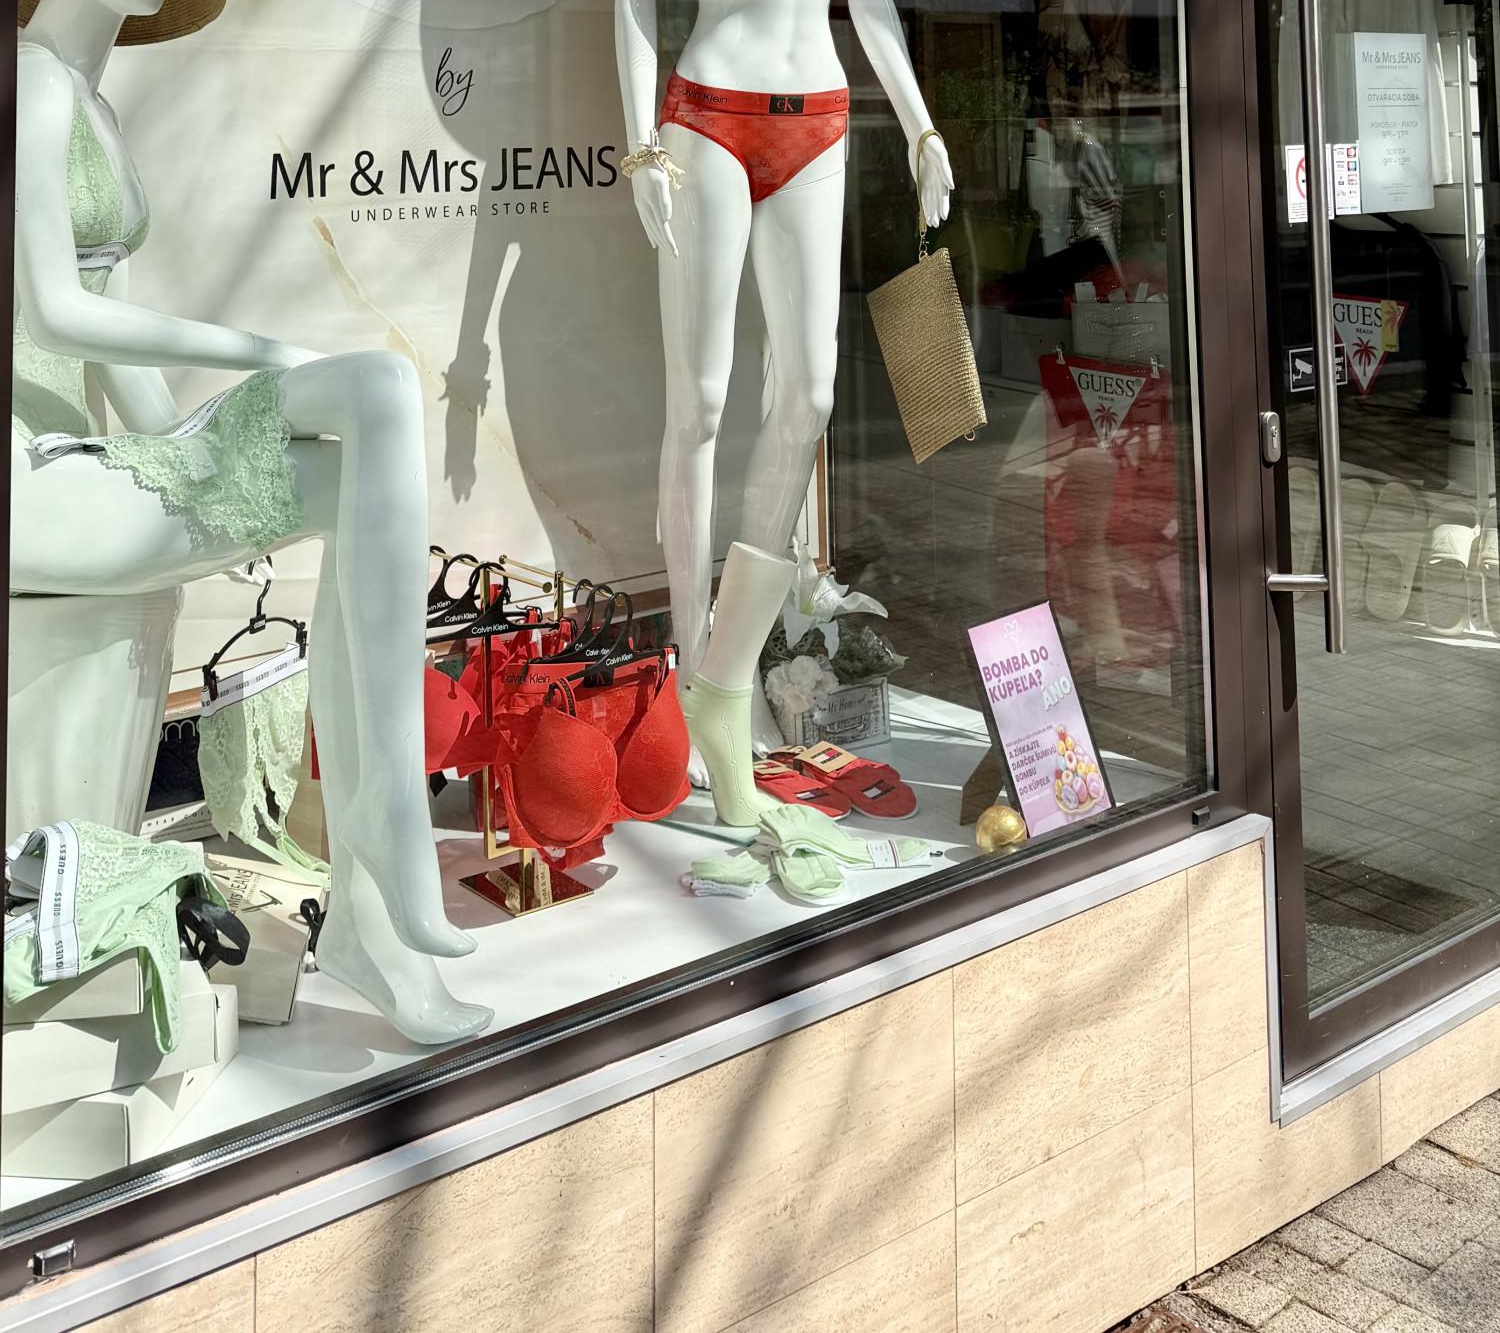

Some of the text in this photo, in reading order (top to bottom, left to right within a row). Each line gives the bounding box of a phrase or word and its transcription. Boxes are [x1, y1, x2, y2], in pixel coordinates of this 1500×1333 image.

[435, 47, 476, 116] by
[270, 146, 618, 199] Mr & Mrs JEANS
[351, 201, 551, 223] UNDERWEAR STORE
[1332, 302, 1384, 328] GUES
[444, 612, 478, 623] Calvin Klein
[471, 623, 509, 635] Calvin Klein
[605, 653, 633, 666] Calvin Klein
[982, 645, 1049, 682] BOMBA DO
[529, 673, 550, 683] Klein
[57, 843, 67, 875] GUESS
[230, 869, 254, 894] JEANS
[53, 891, 62, 916] GUESS
[55, 939, 64, 969] GUESS
